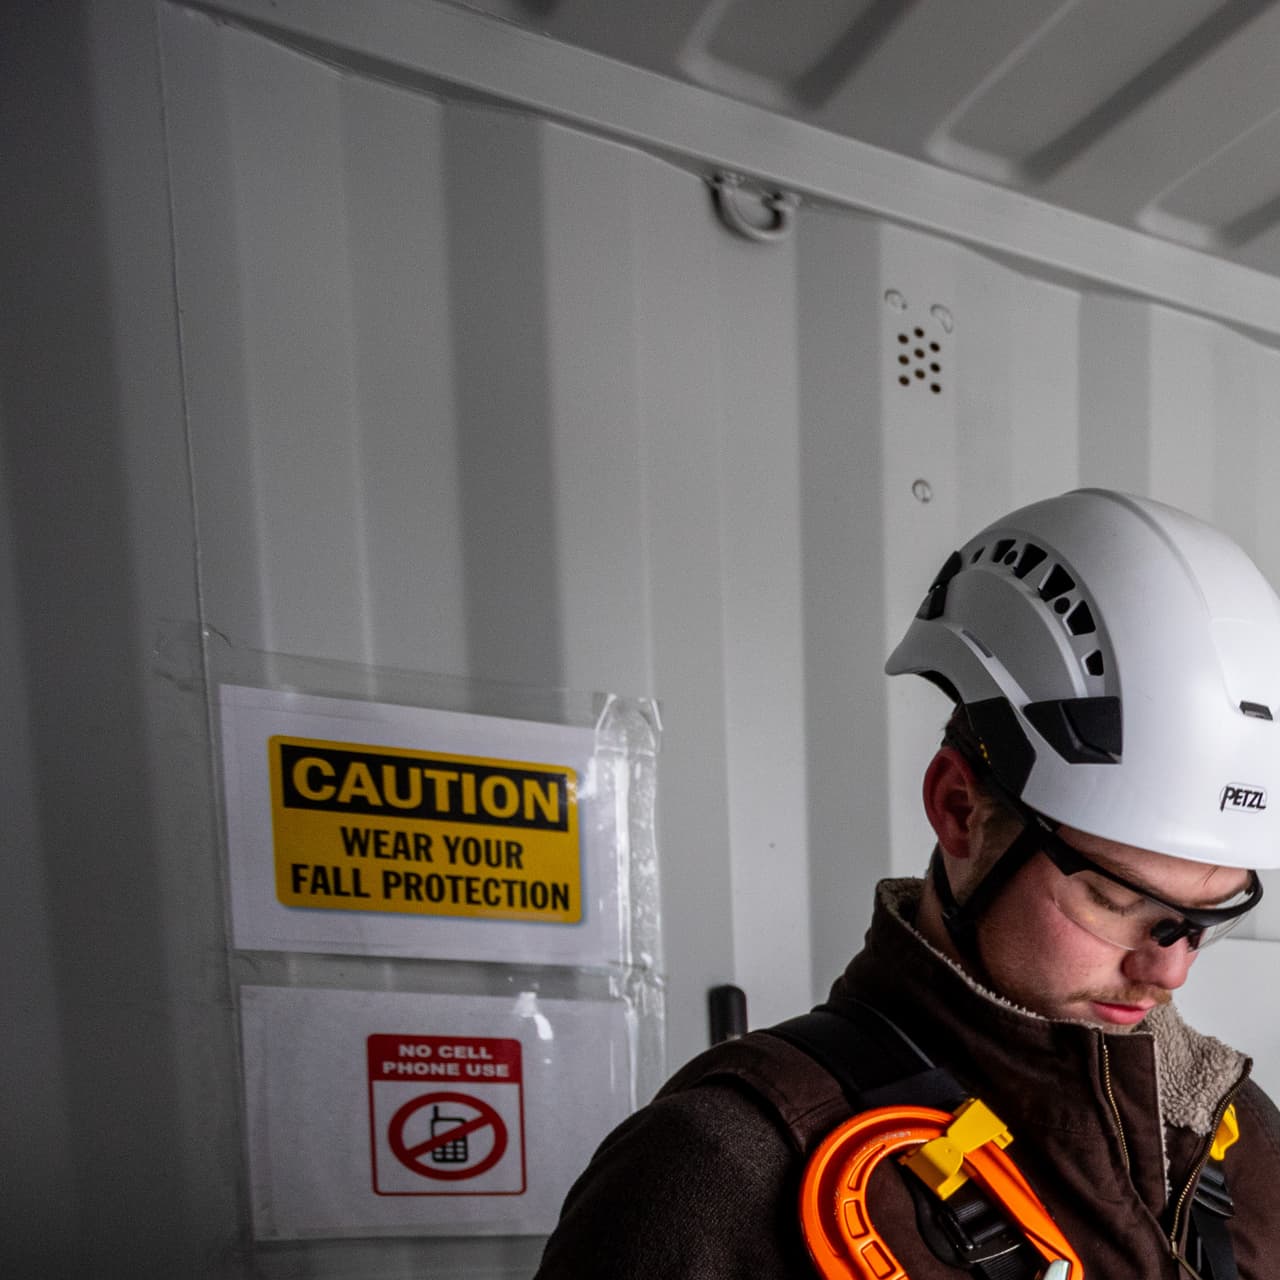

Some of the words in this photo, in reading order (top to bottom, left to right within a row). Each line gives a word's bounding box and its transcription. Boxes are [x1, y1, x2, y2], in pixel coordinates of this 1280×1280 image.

[292, 757, 560, 823] CAUTION
[1219, 785, 1266, 812] PETZL
[340, 826, 433, 863] WEAR
[443, 834, 524, 870] YOUR
[291, 863, 371, 898] FALL
[382, 870, 570, 911] PROTECTION
[382, 1061, 461, 1077] PHONE
[466, 1063, 510, 1078] USE
[398, 1044, 432, 1058] NO
[437, 1045, 493, 1060] CELL
